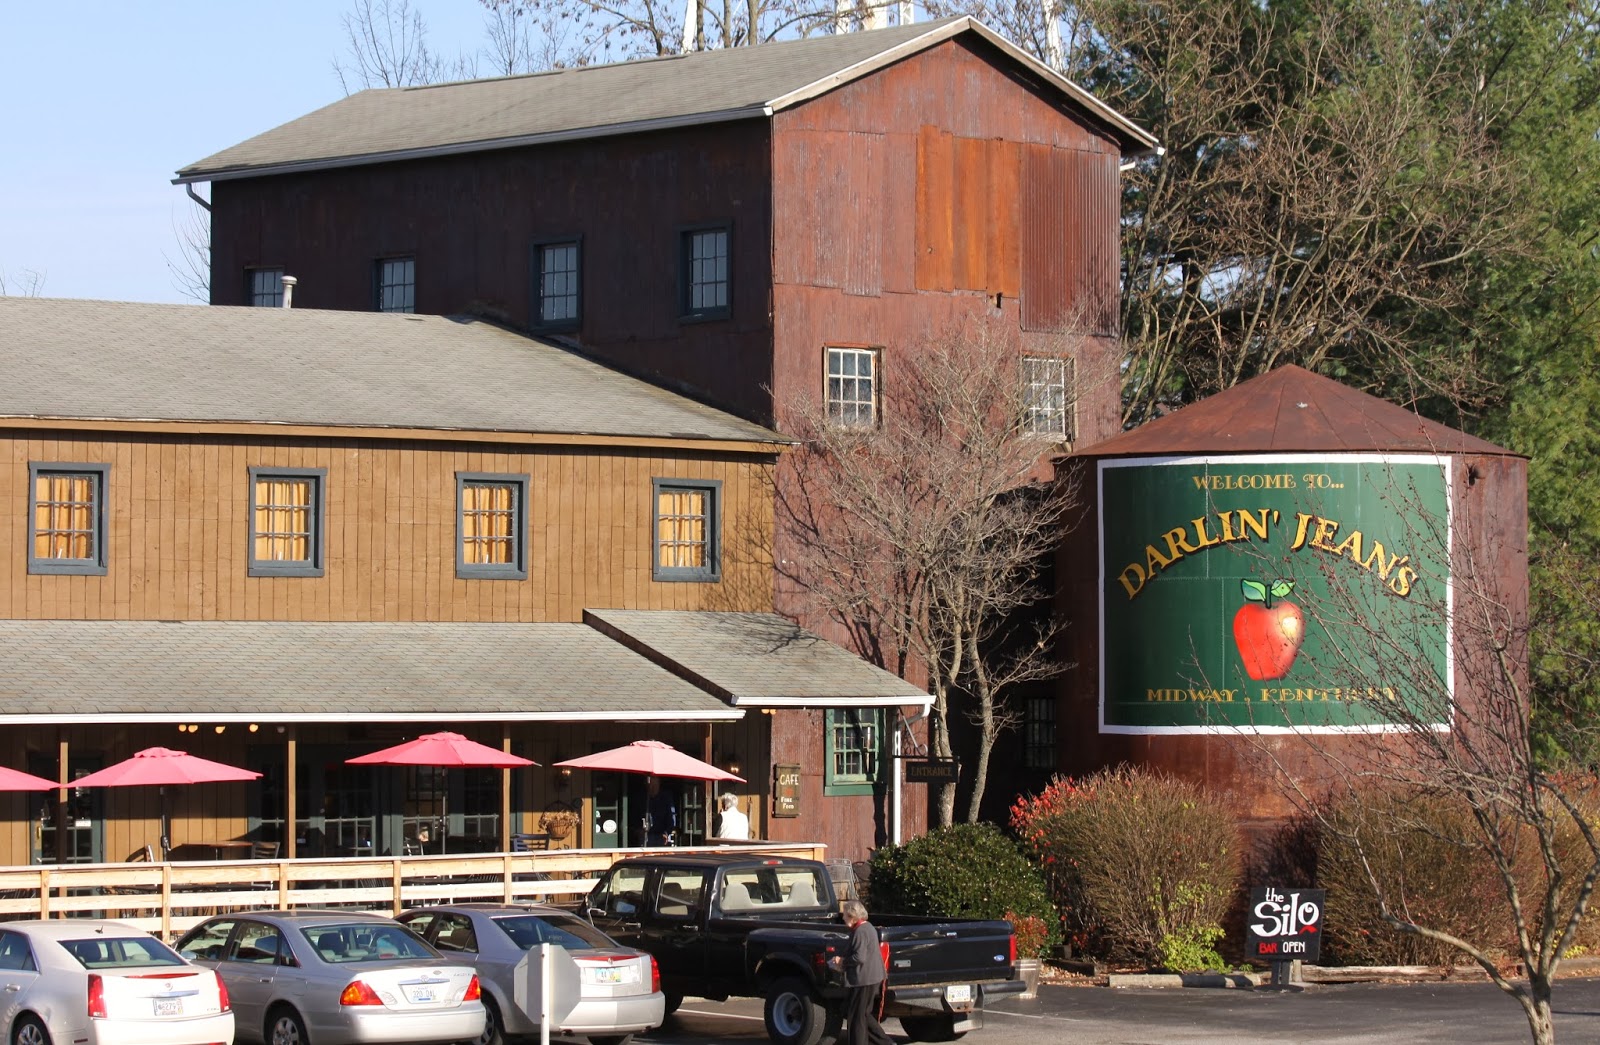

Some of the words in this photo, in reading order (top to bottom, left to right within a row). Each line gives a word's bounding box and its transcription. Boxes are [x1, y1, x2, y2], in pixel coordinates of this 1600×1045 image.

[1192, 473, 1297, 490] WELCOME
[1117, 508, 1280, 600] DARLIN'
[1290, 512, 1418, 596] JEAN'S
[911, 767, 952, 776] ENTRANCE
[780, 774, 799, 786] CAFE
[1265, 888, 1284, 902] the
[1250, 893, 1319, 937] Silo
[1259, 942, 1277, 954] BAR
[1283, 942, 1305, 953] OPEN
